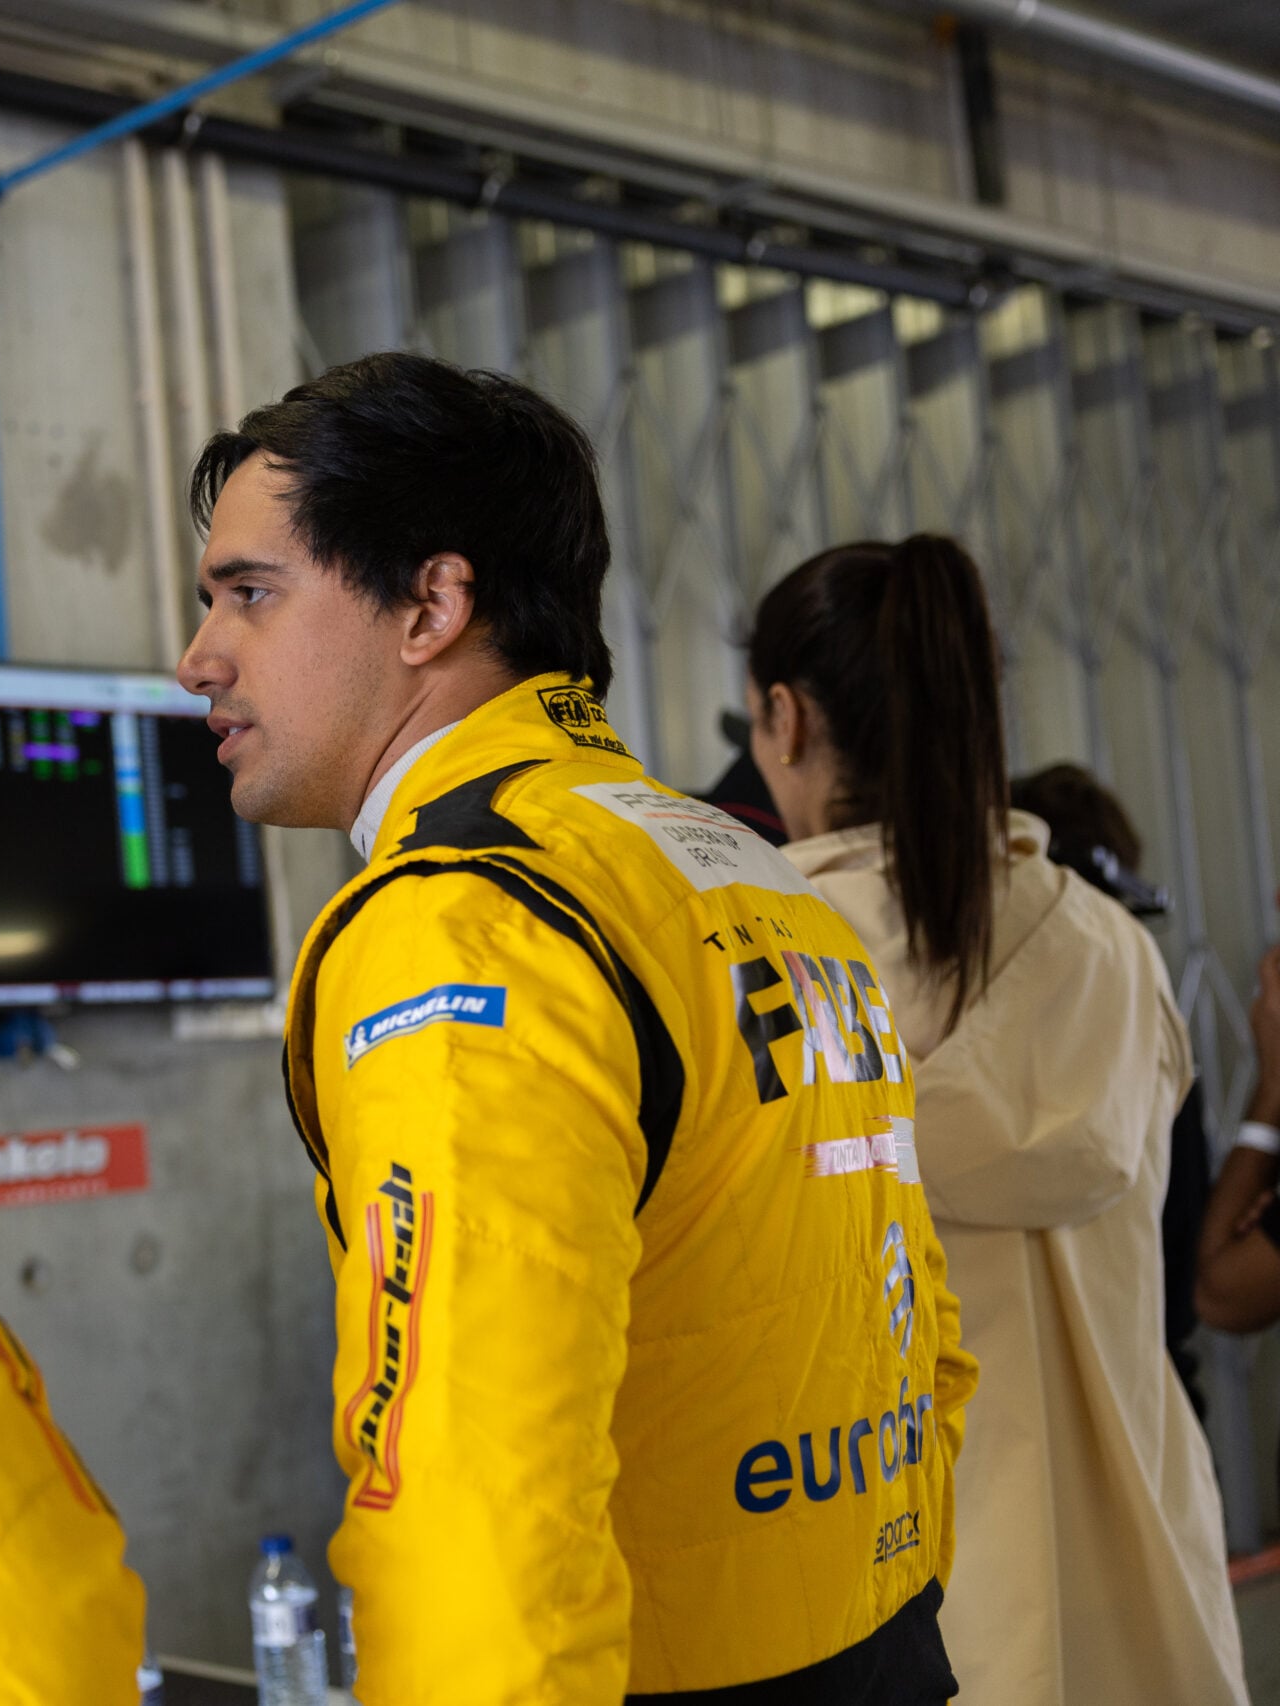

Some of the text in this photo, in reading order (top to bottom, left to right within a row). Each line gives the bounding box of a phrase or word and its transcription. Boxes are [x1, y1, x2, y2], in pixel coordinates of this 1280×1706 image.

[551, 699, 587, 723] FIA
[370, 995, 488, 1041] MICHELIN
[729, 950, 908, 1105] FARBE
